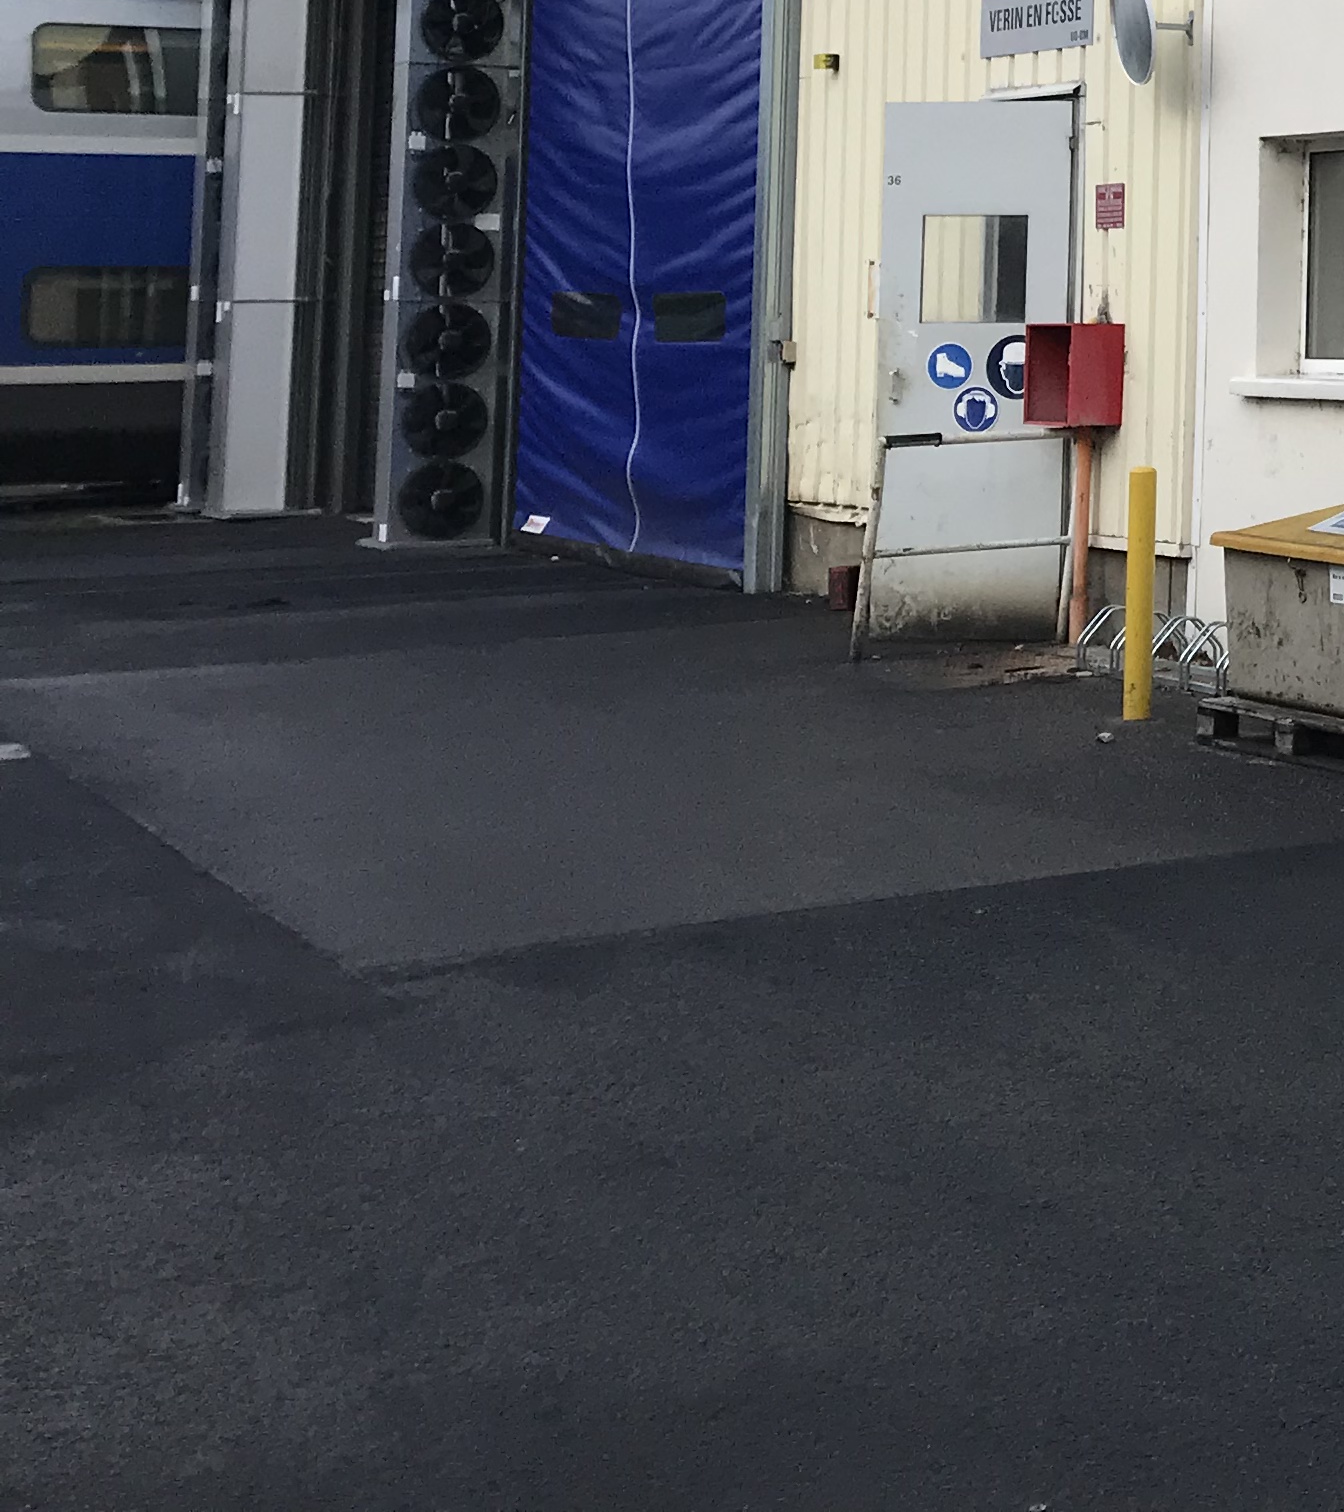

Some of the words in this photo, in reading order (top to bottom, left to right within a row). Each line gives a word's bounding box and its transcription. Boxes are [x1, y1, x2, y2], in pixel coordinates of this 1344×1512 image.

[989, 6, 1024, 33] VERIN
[1026, 3, 1042, 28] EN
[887, 175, 902, 186] 36
